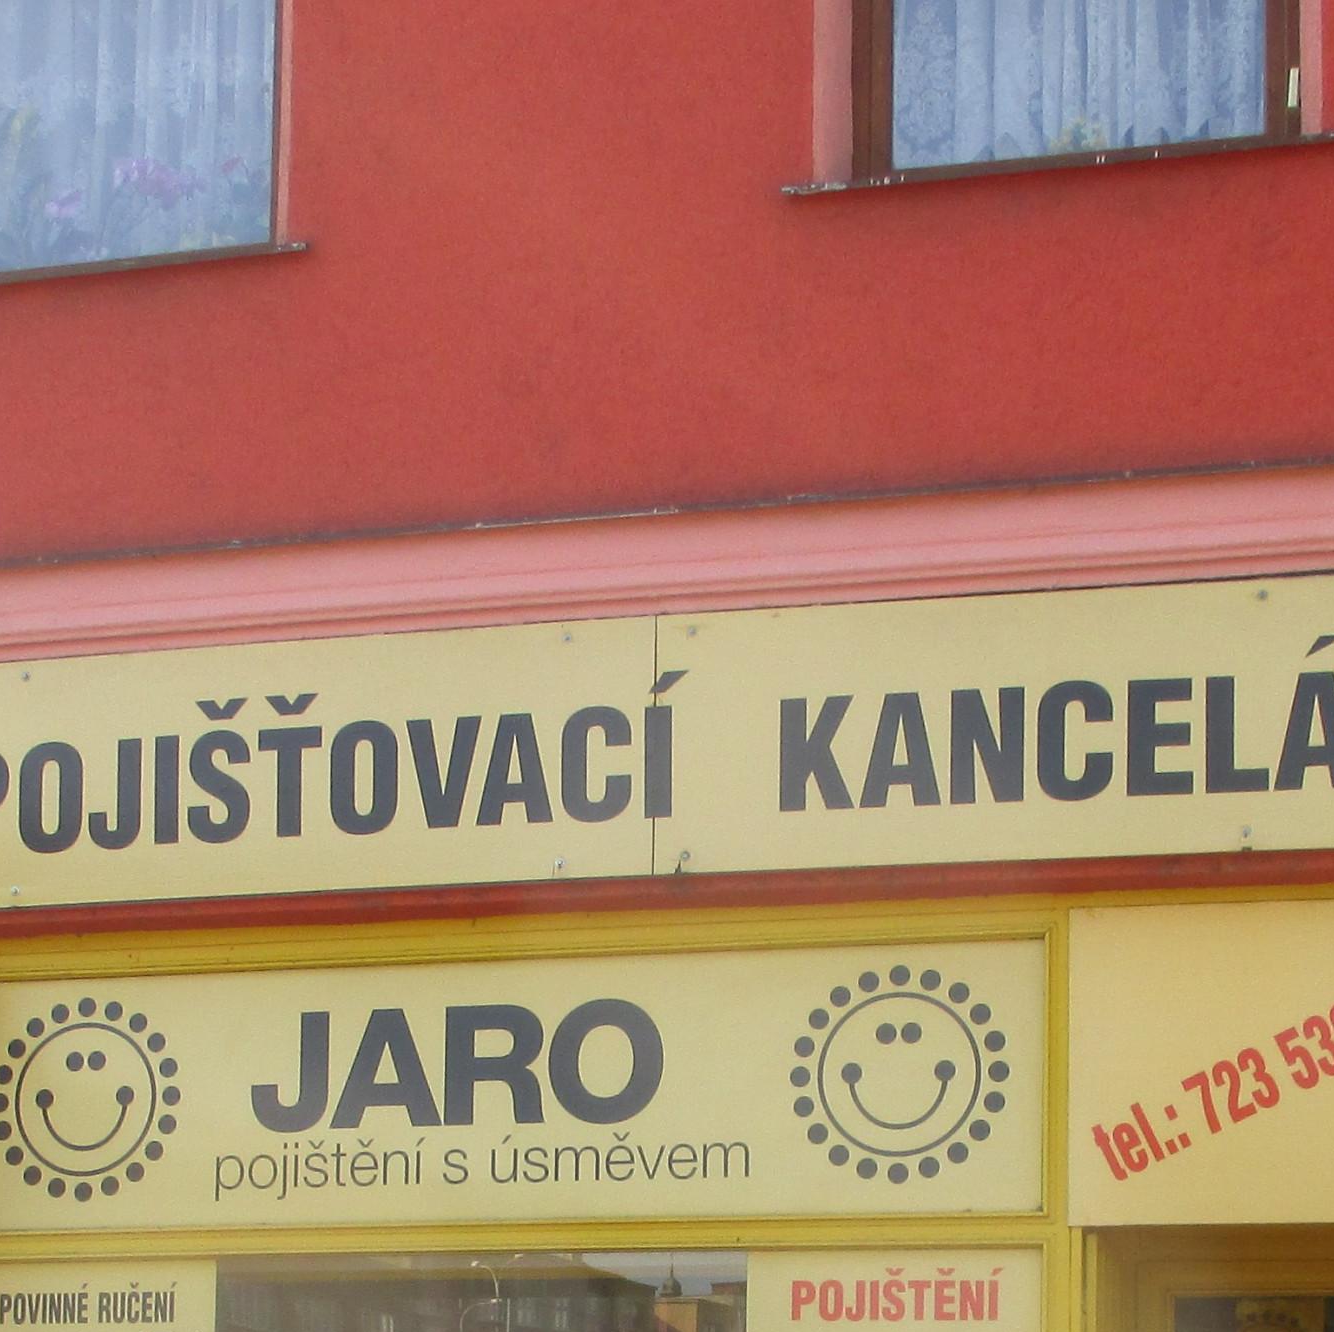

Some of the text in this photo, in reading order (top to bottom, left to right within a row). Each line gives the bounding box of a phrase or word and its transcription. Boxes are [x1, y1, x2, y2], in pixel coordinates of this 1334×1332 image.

[250, 997, 665, 1135] JARO
[1091, 1102, 1192, 1181] tel.:
[1180, 1047, 1280, 1135] 723
[214, 1132, 750, 1201] pojištění s úsměvem
[97, 1281, 177, 1324] RUČENÍ
[790, 1267, 1004, 1322] POJIŠTĚNÍ
